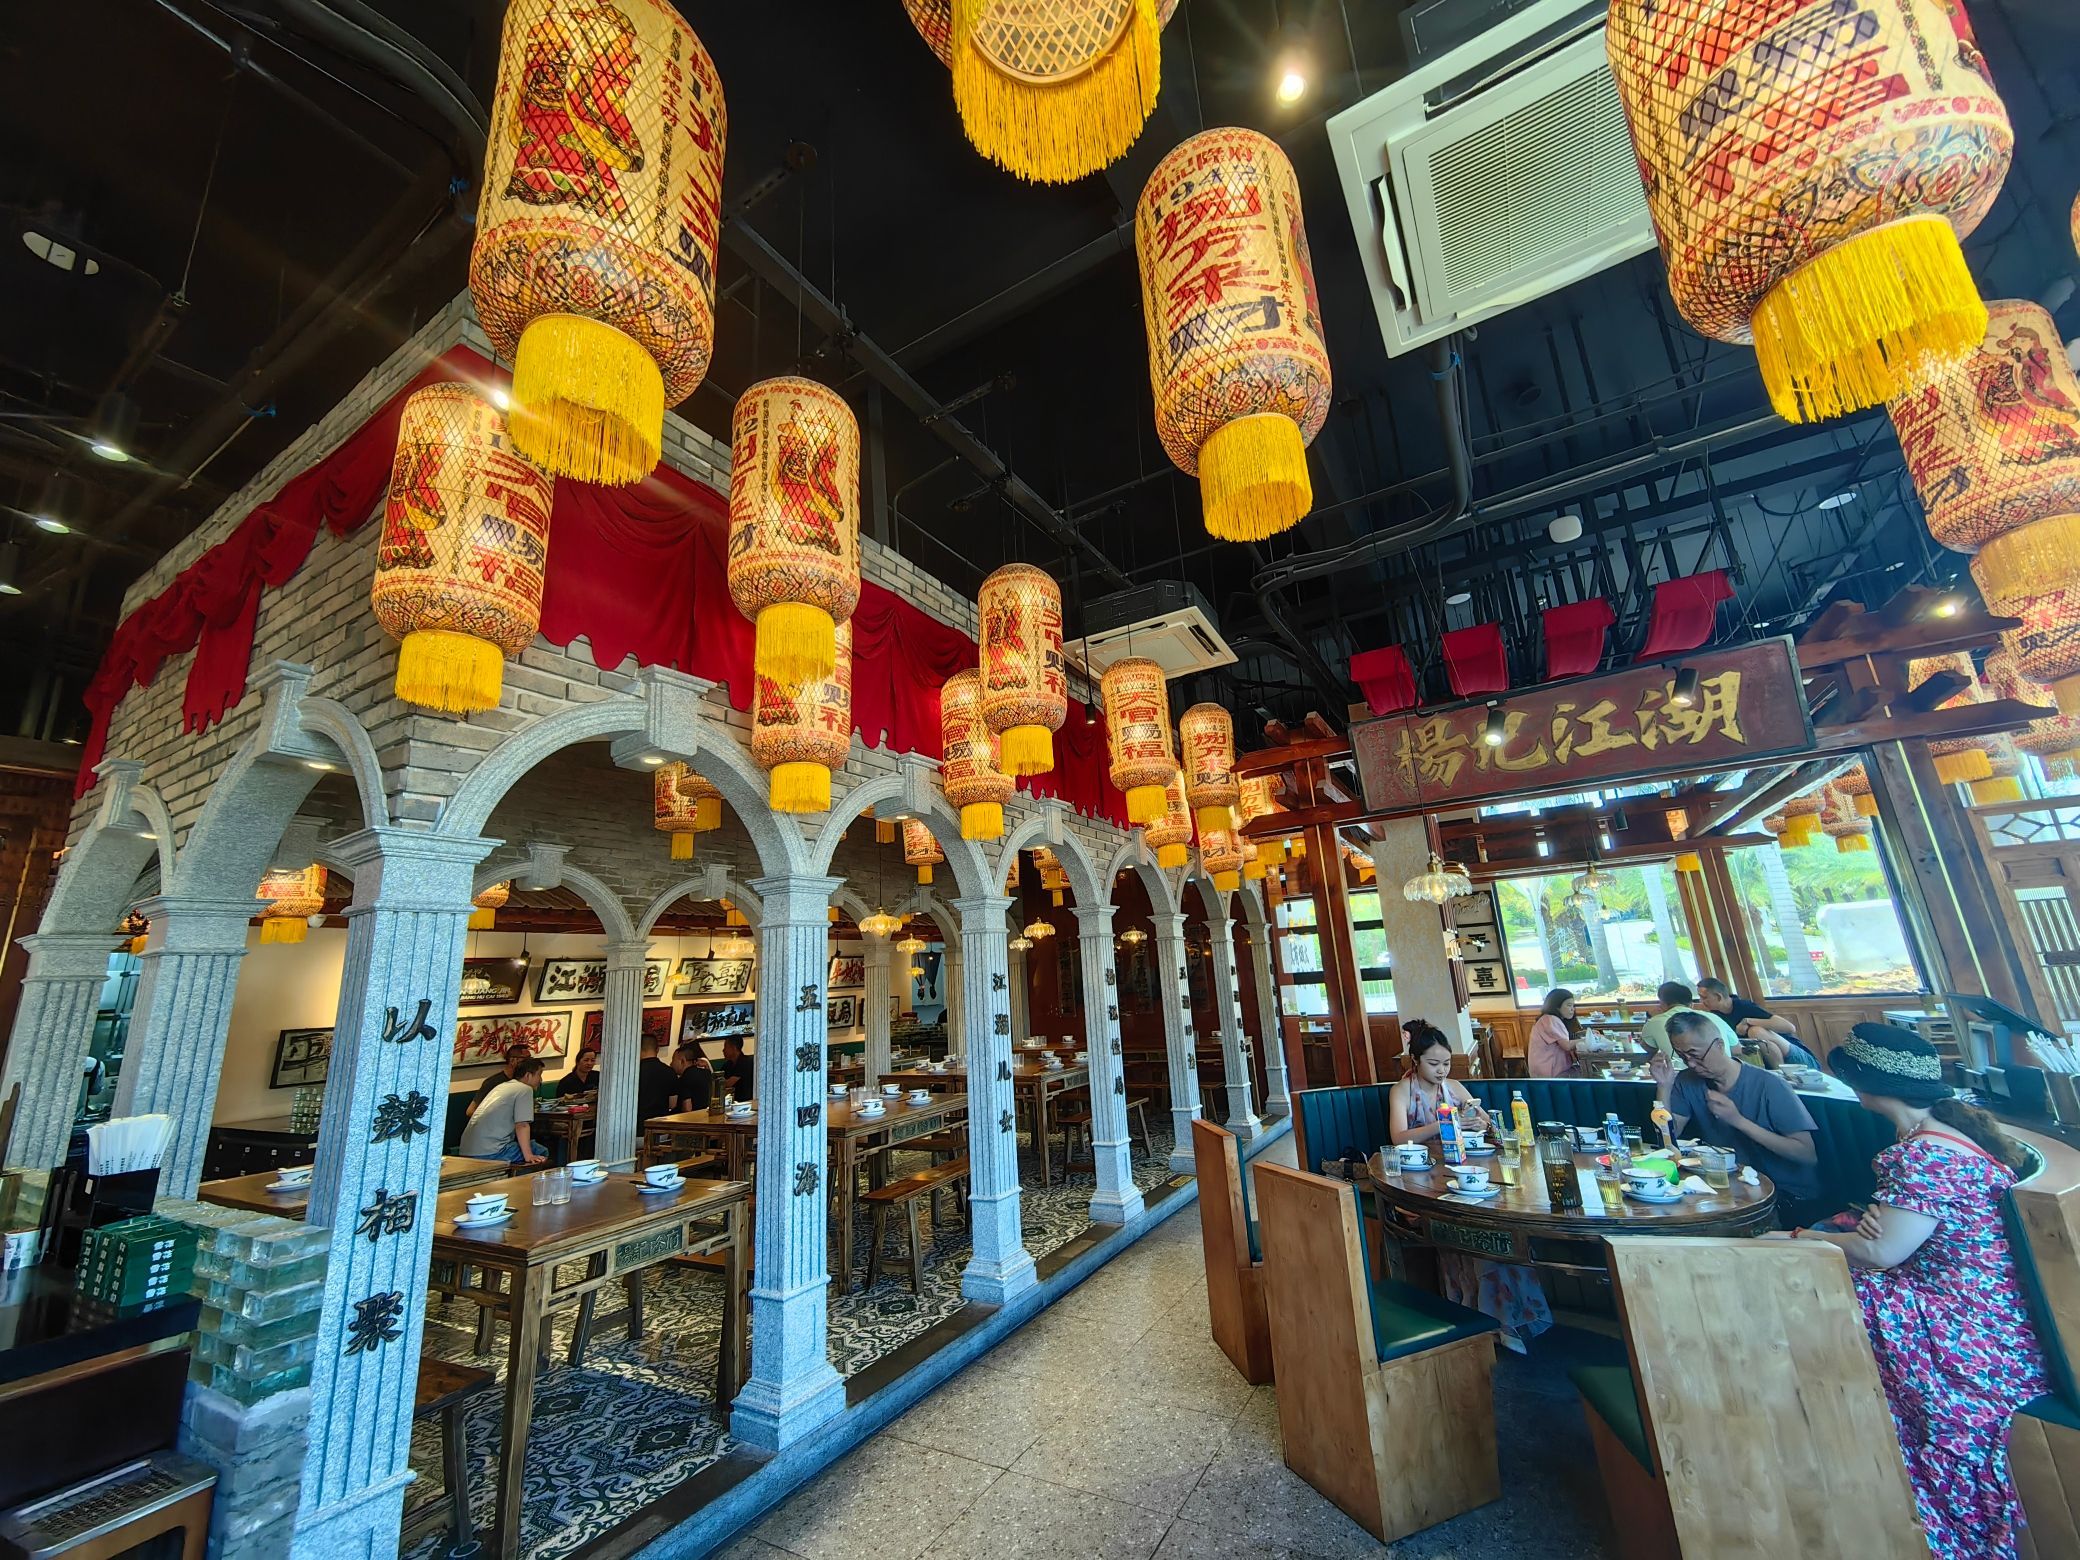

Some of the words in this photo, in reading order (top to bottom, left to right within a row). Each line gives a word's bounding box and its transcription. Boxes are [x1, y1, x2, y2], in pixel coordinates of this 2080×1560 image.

[793, 983, 822, 1197] 五湖四海
[992, 972, 1014, 1134] 江湖儿女
[343, 998, 438, 1357] 以辣相聚
